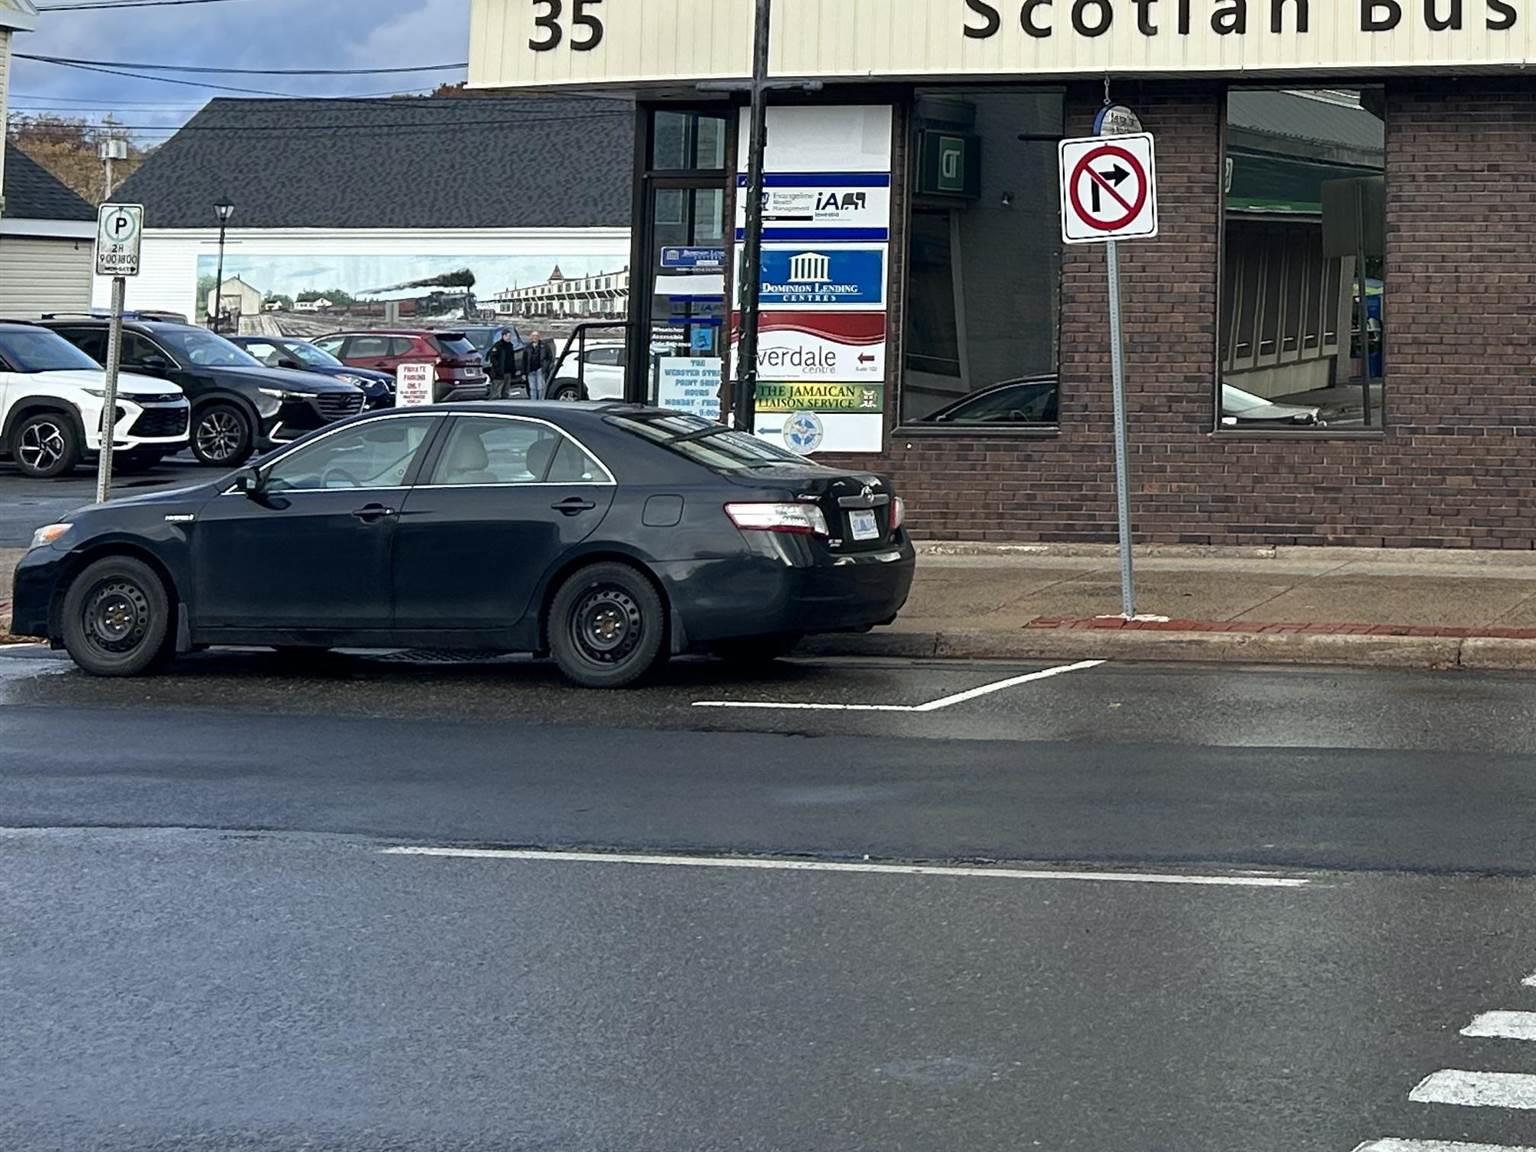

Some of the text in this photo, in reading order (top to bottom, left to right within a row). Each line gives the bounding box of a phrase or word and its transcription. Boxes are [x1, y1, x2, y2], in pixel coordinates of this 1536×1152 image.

[115, 217, 127, 234] P
[762, 283, 858, 293] DOMINION LENDING
[757, 345, 836, 367] verdale
[664, 369, 700, 377] WEBSTER
[802, 366, 836, 374] centre
[684, 389, 709, 397] HOURS
[759, 386, 855, 398] THE JAMAICAN
[758, 398, 855, 409] LIAISON SERVICE
